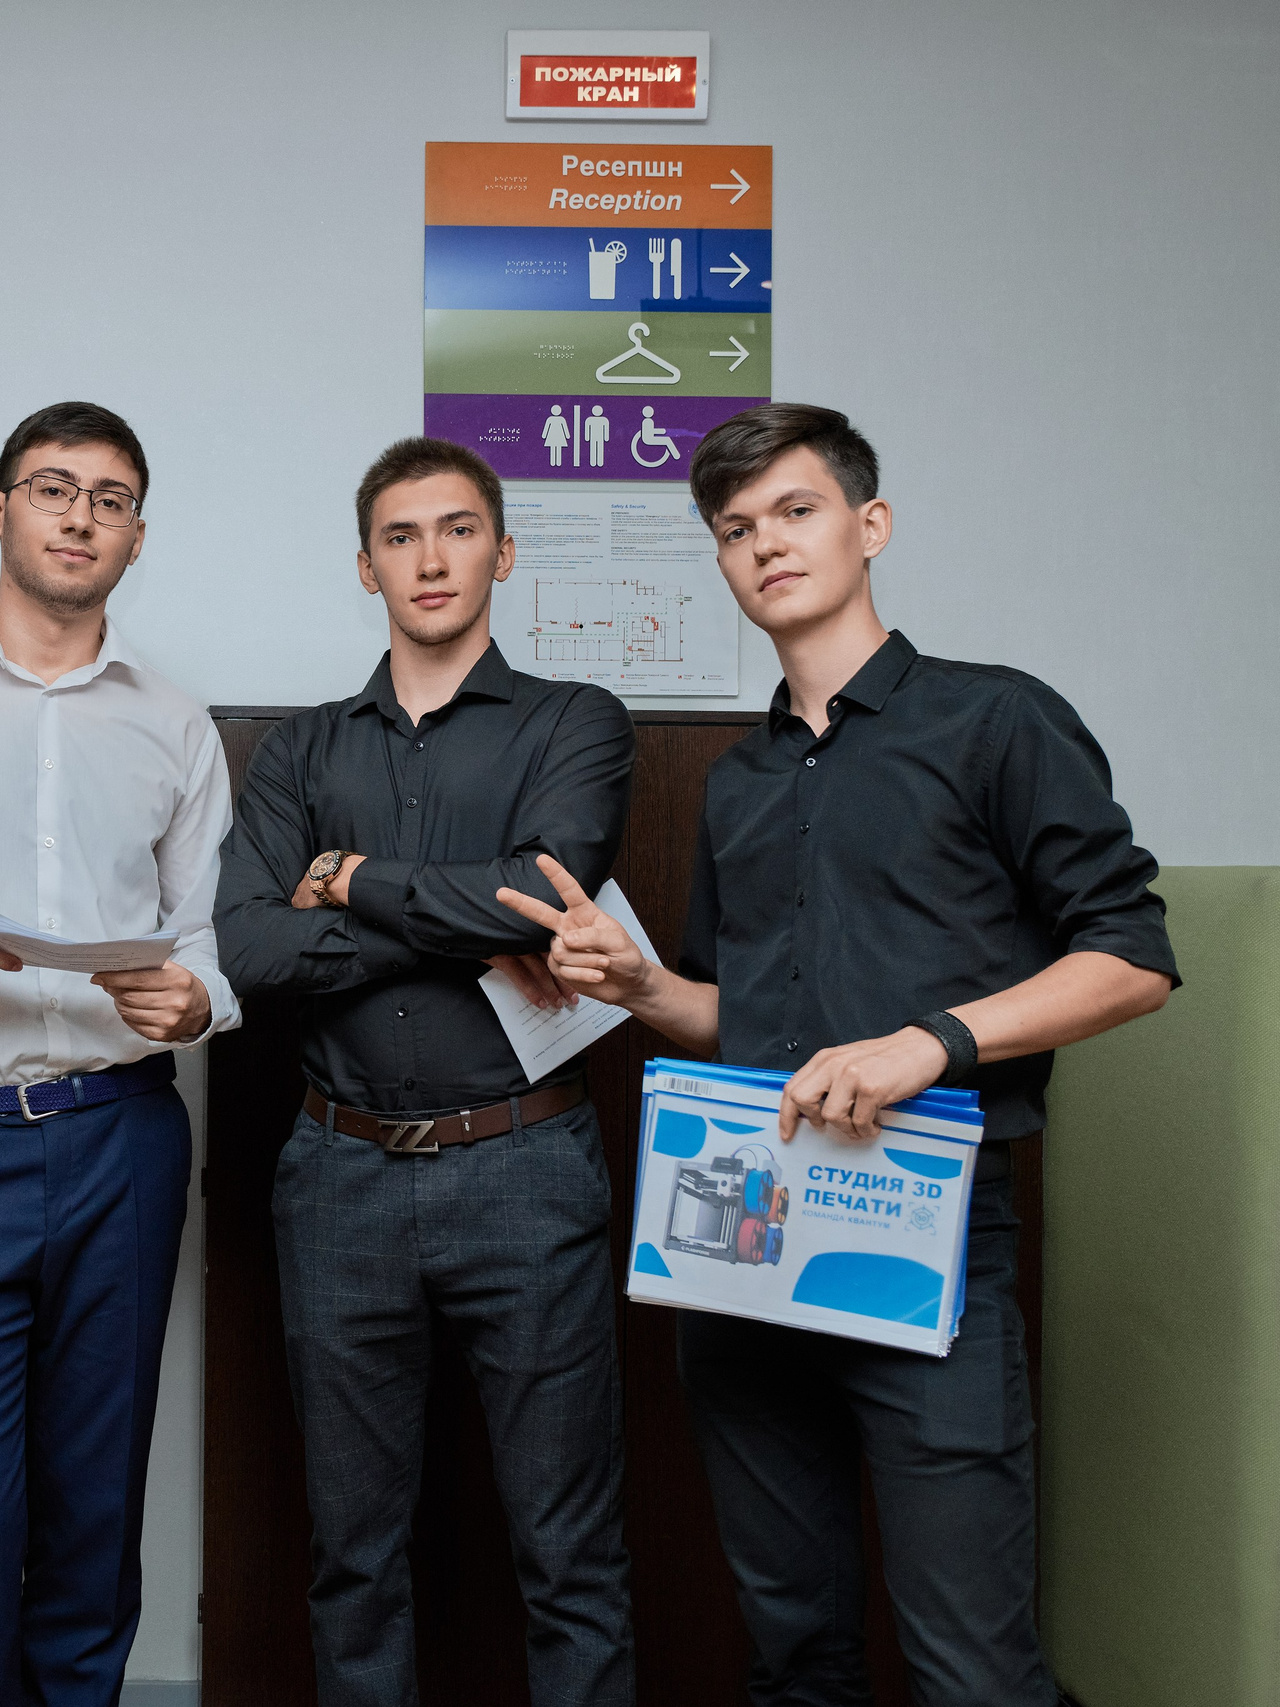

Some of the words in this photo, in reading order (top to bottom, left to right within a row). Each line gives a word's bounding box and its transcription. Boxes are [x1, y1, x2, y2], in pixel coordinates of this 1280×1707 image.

[534, 63, 682, 83] ПОЖАРНЫЙ
[577, 86, 640, 102] КРАН
[562, 154, 683, 177] Ресепшн
[548, 188, 683, 215] Reception
[807, 1165, 905, 1194] СТУДИЯ
[911, 1181, 943, 1199] 3D
[803, 1188, 902, 1218] ПЕЧАТИ
[801, 1209, 845, 1222] КОМАНДА
[847, 1216, 891, 1229] КВАНТУМ
